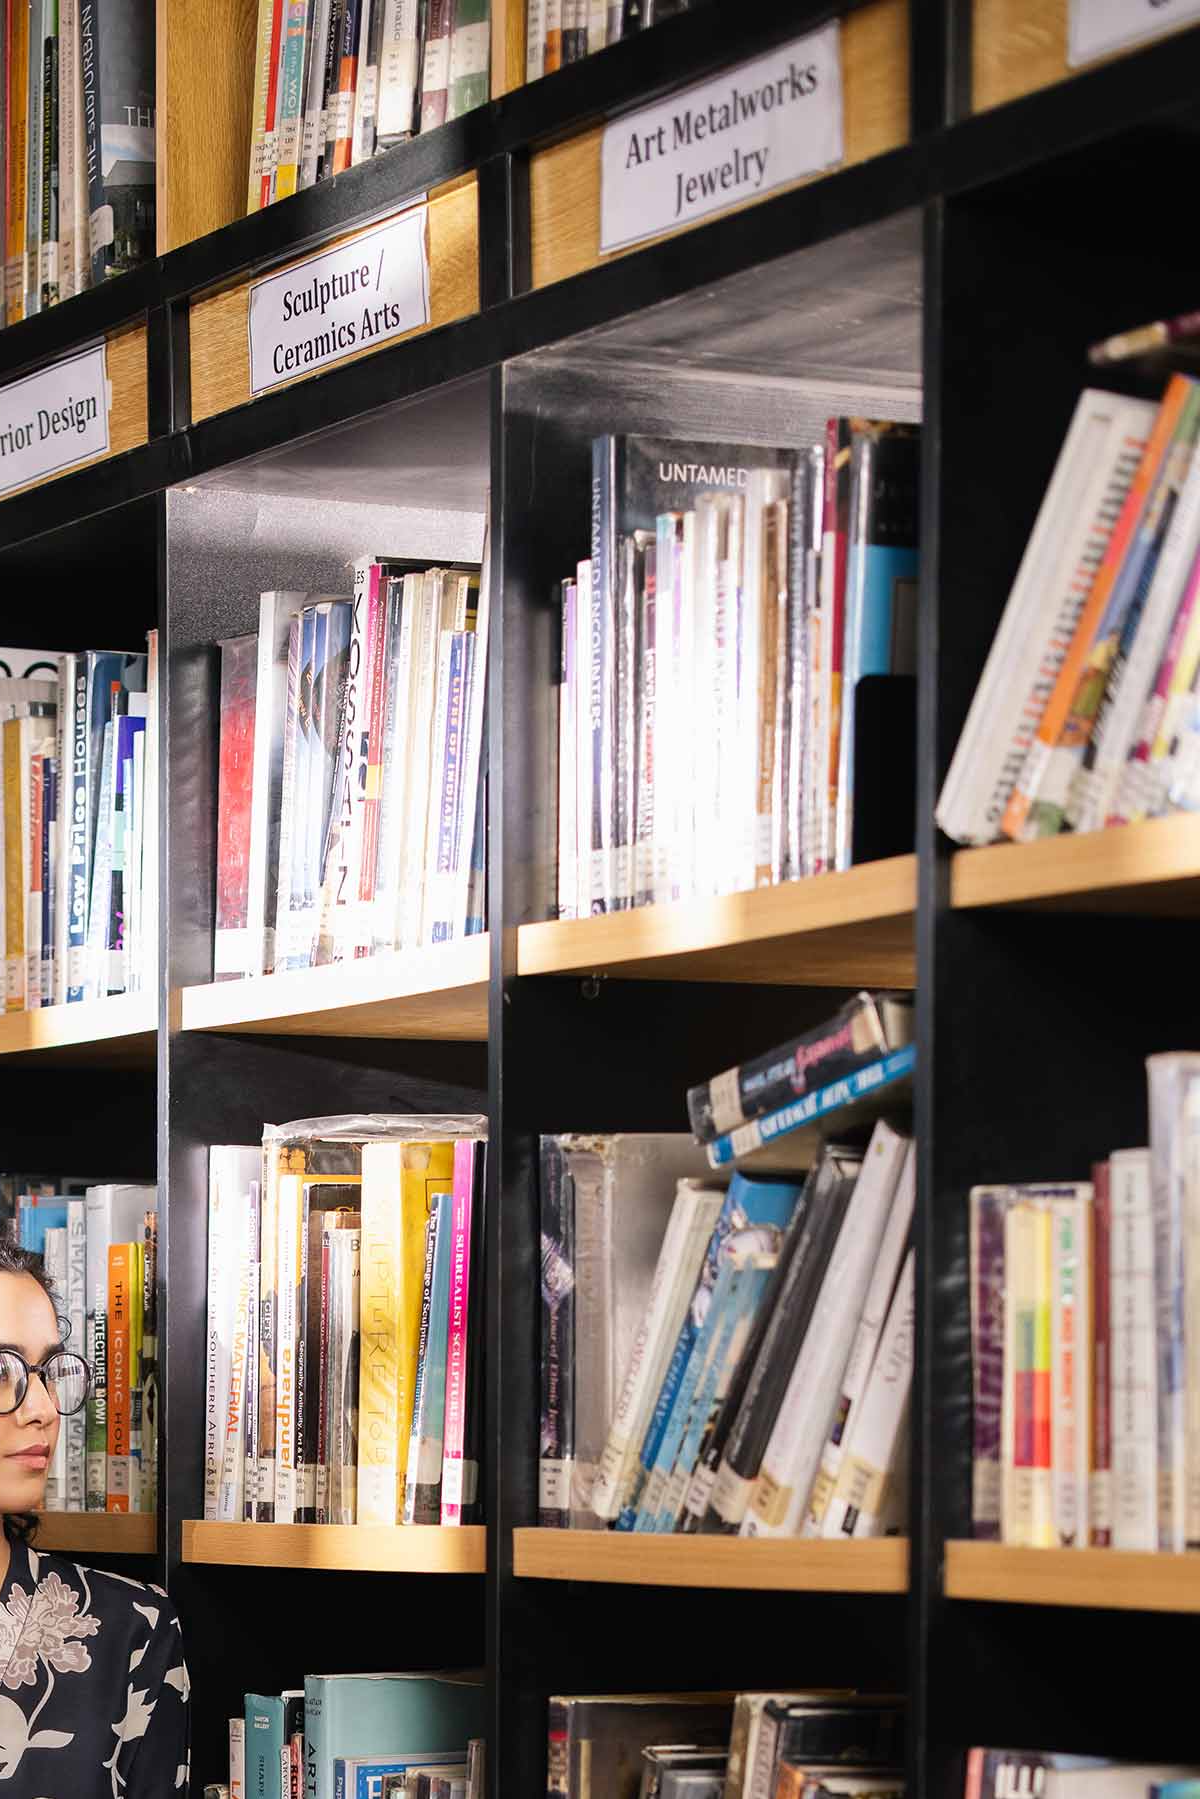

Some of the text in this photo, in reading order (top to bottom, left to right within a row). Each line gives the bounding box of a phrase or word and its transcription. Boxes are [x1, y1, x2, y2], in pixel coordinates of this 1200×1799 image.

[626, 62, 818, 169] Art Metalworks
[675, 144, 770, 216] Jewelry
[283, 248, 385, 322] Sculpture /
[273, 301, 400, 375] Ceramics Arts
[38, 396, 97, 441] Design
[659, 462, 749, 487] UNTAMED
[591, 479, 602, 732] UNTAMED ENCOUNTERS
[70, 675, 88, 935] Low Price Houses
[429, 1208, 439, 1230] The
[424, 1232, 437, 1287] Language
[95, 1283, 107, 1425] ARCHITECTURE NOW!
[114, 1281, 124, 1404] THE ICONIC
[264, 1302, 273, 1340] GIFTS
[418, 1303, 430, 1357] Sculpture
[448, 1233, 465, 1423] SURREALIST SCULPTURE
[209, 1330, 219, 1414] SOUTHERN
[227, 1332, 246, 1440] MATERIAL
[257, 1755, 265, 1793] SHAPE
[307, 1742, 317, 1797] ART
